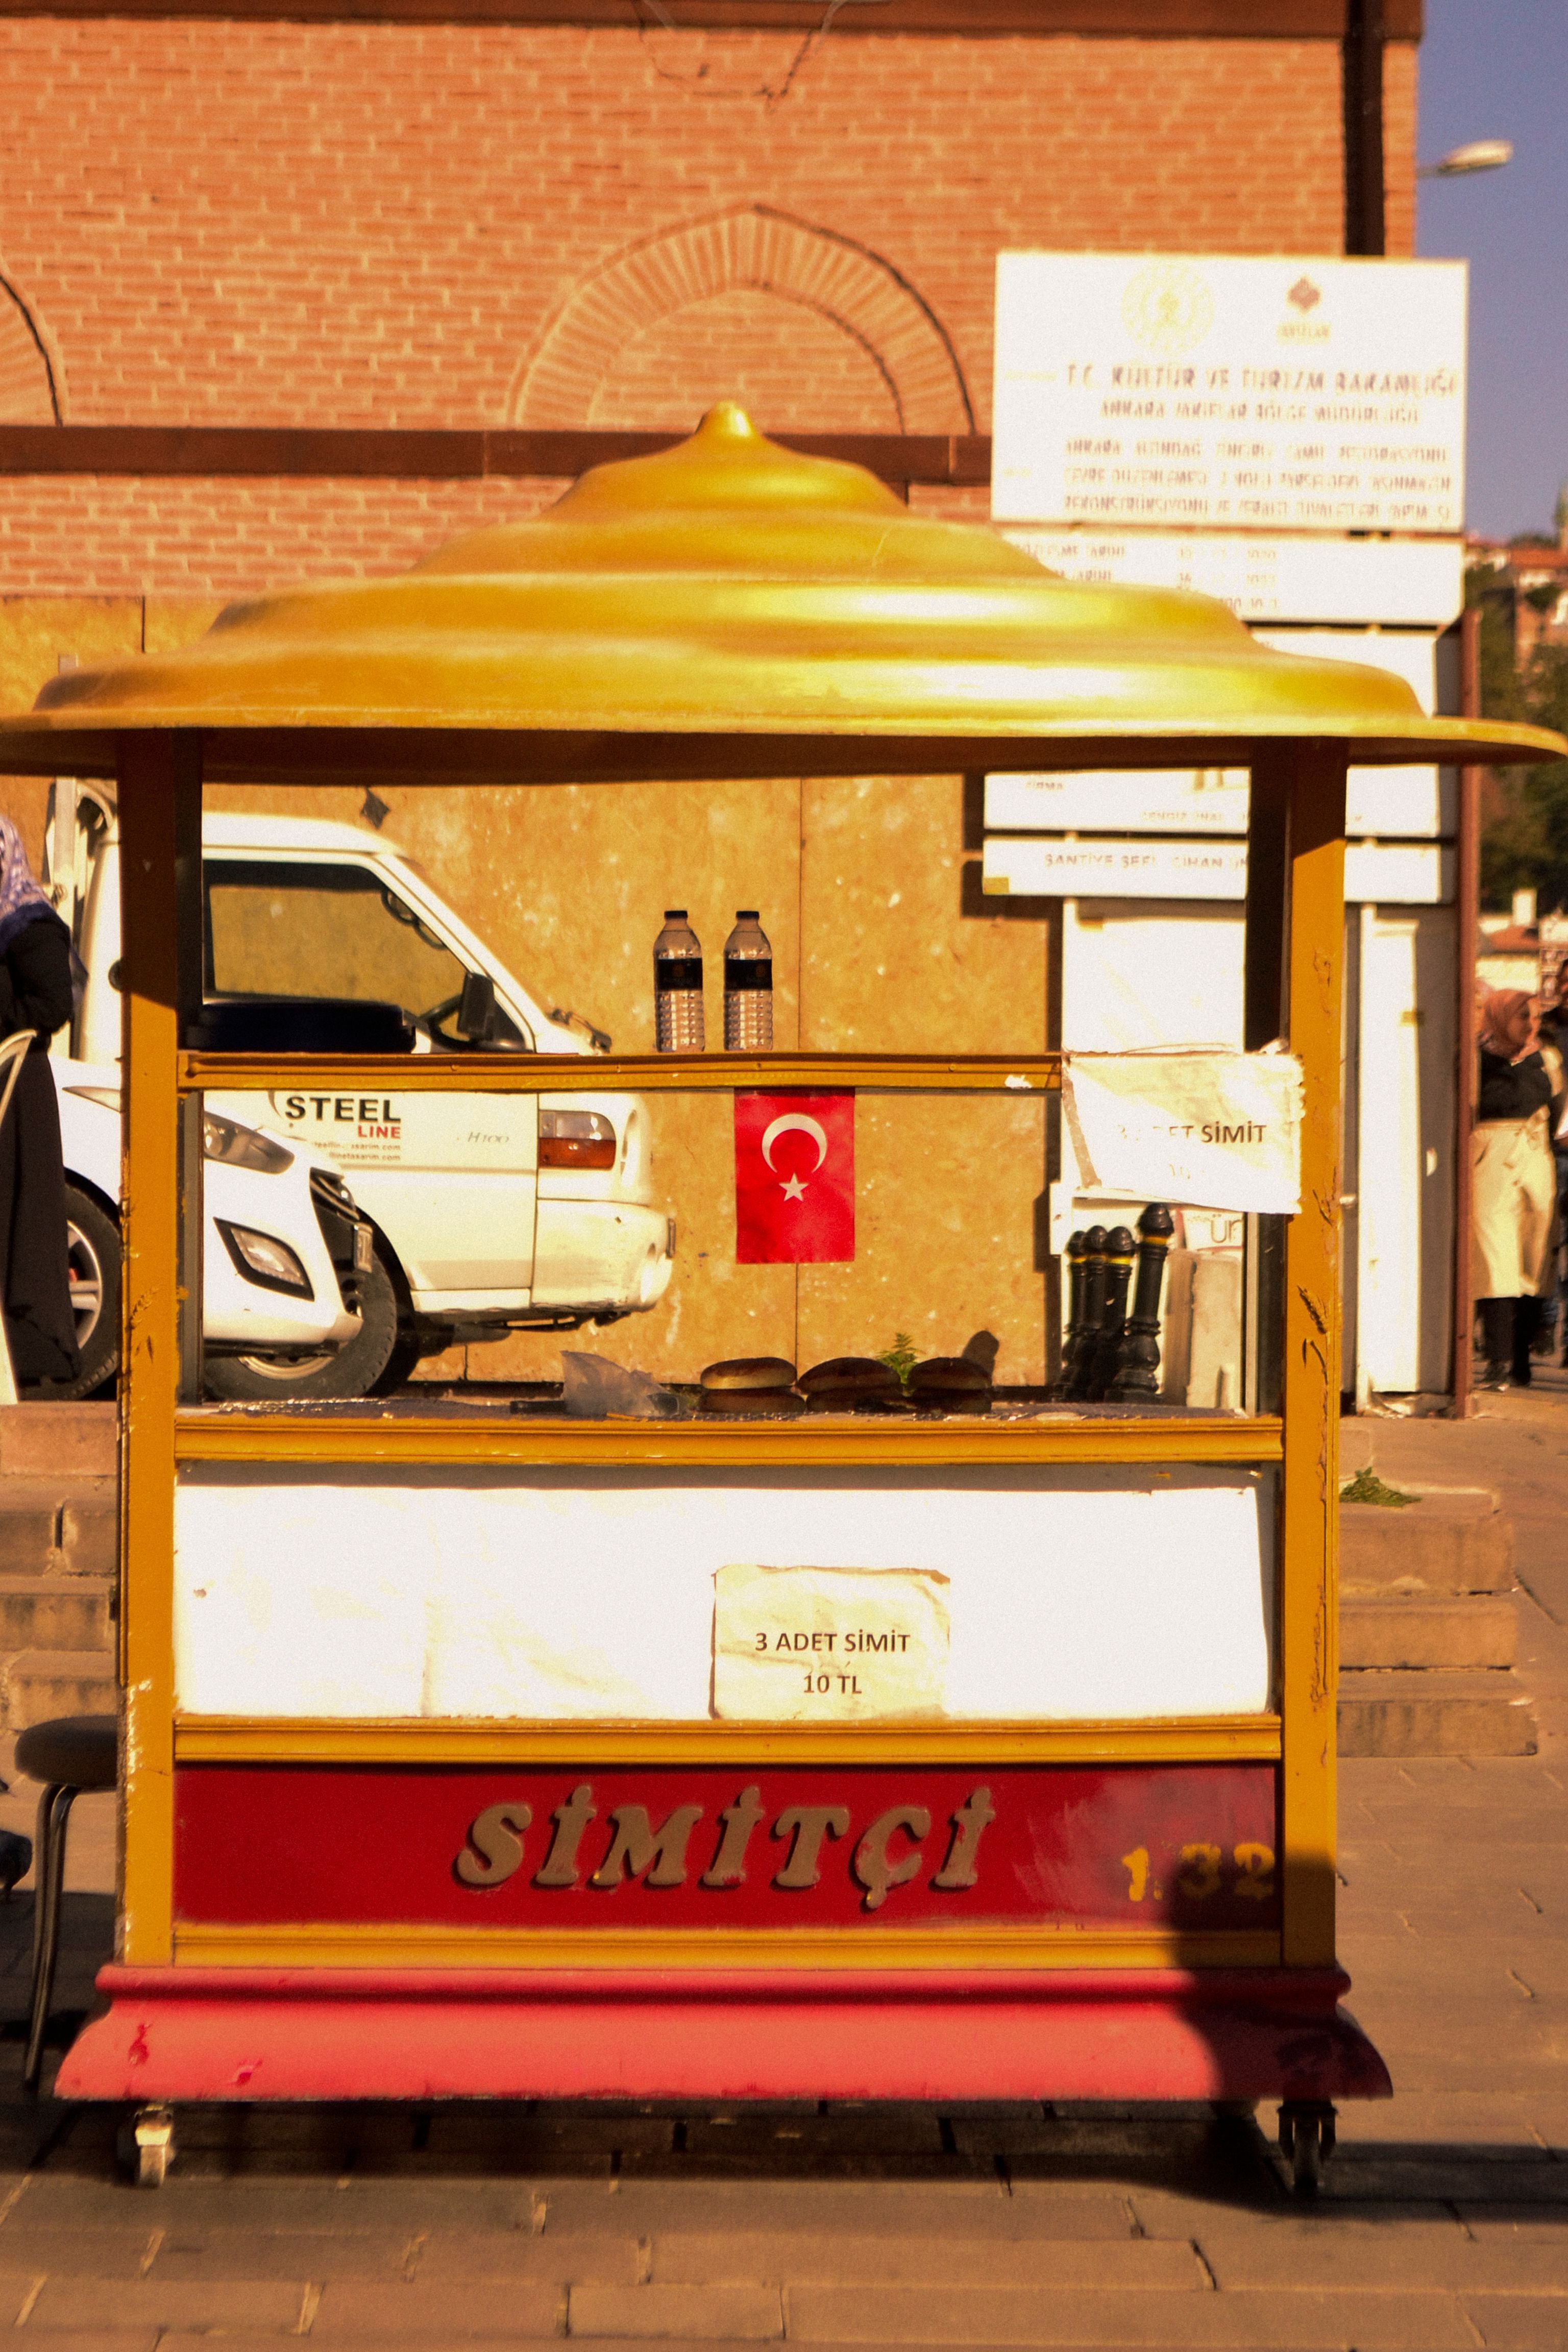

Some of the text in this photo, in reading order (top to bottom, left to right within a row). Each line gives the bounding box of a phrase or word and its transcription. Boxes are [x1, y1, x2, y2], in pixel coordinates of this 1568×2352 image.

[285, 1096, 401, 1123] STEEL
[358, 1125, 401, 1139] LINE
[1201, 1121, 1267, 1143] SİMİT
[754, 1629, 911, 1653] 3 ADET SİMİT
[804, 1674, 862, 1694] 10 TL
[454, 1784, 996, 1909] SİMİTÇİ
